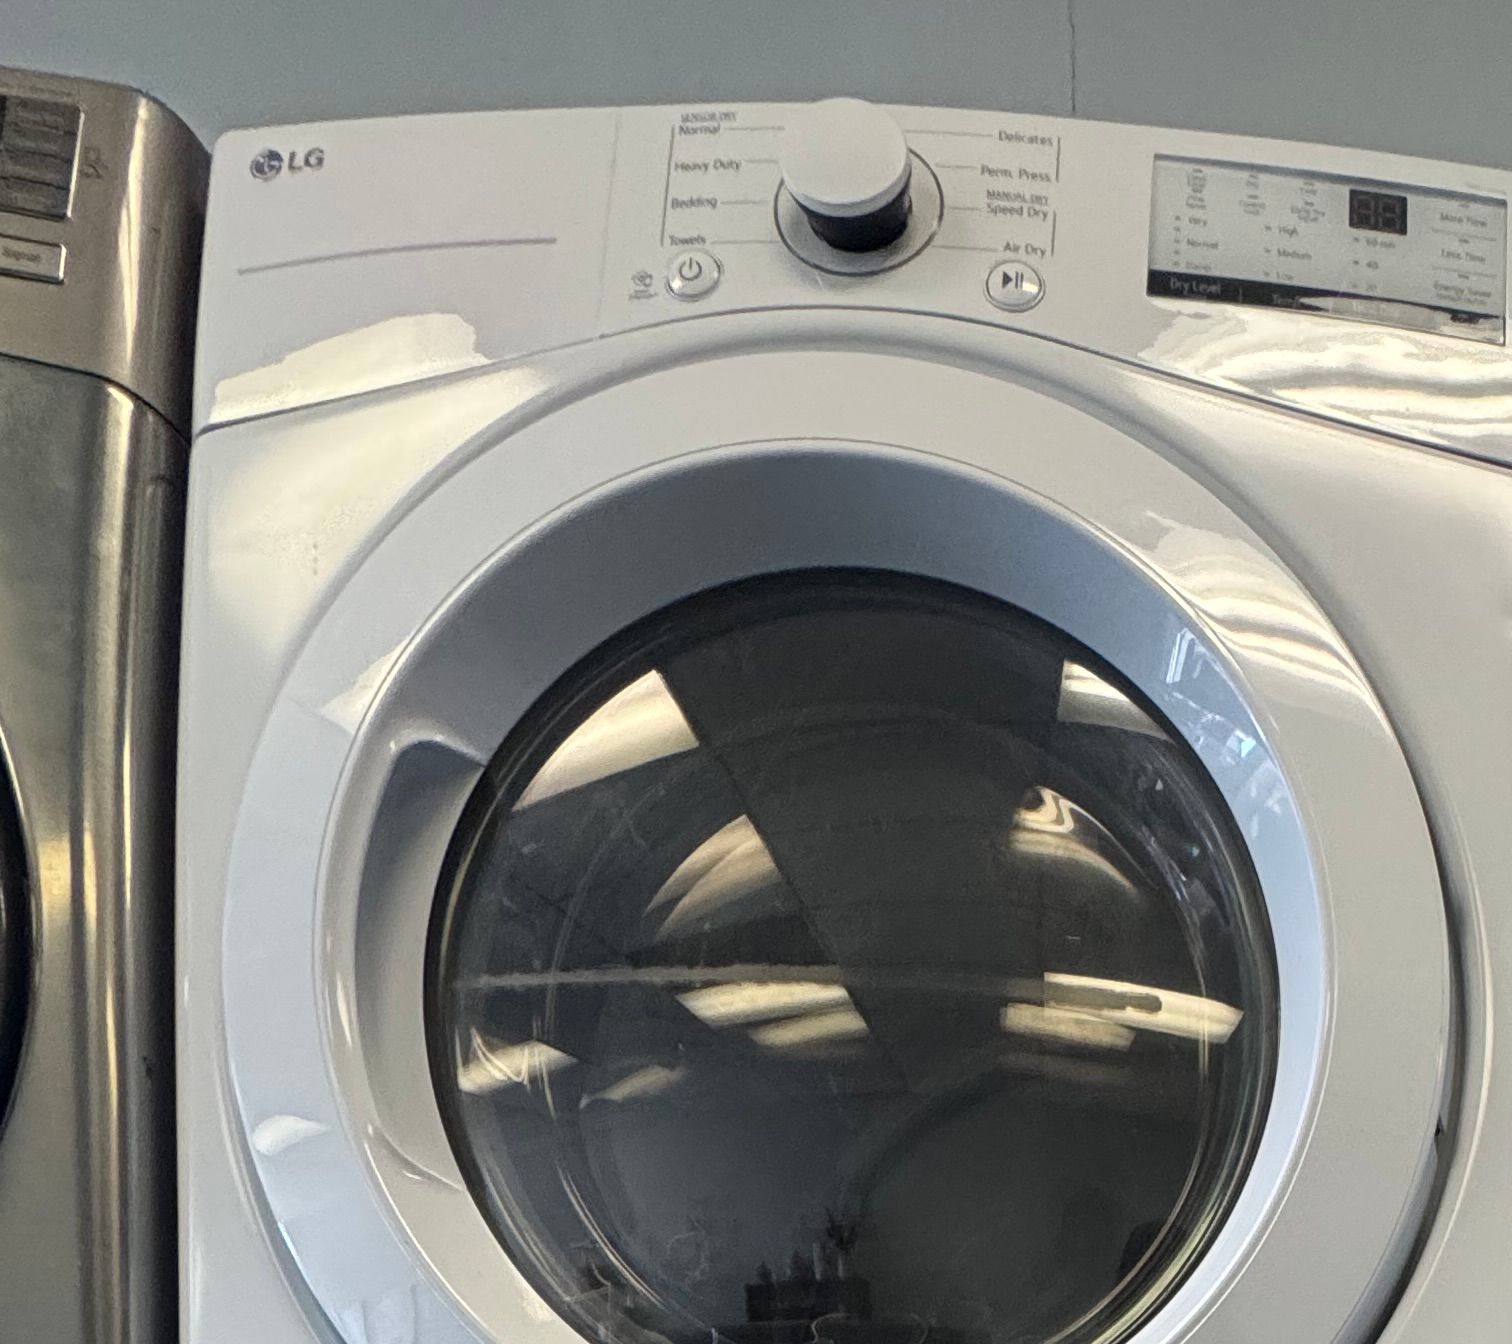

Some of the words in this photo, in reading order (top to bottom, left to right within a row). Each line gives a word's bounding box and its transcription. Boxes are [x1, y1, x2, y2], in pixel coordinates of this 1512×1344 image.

[679, 123, 721, 135] Normal
[998, 130, 1054, 146] Delicates
[287, 147, 326, 173] LG
[674, 161, 710, 173] Heavy
[712, 158, 742, 171] Duty
[1018, 168, 1052, 183] Press
[671, 196, 719, 210] Bedding
[986, 203, 1024, 217] Speed
[1027, 206, 1049, 221] Dry
[669, 234, 707, 246] Towels
[1003, 241, 1021, 253] Air
[1025, 243, 1047, 258] Dry
